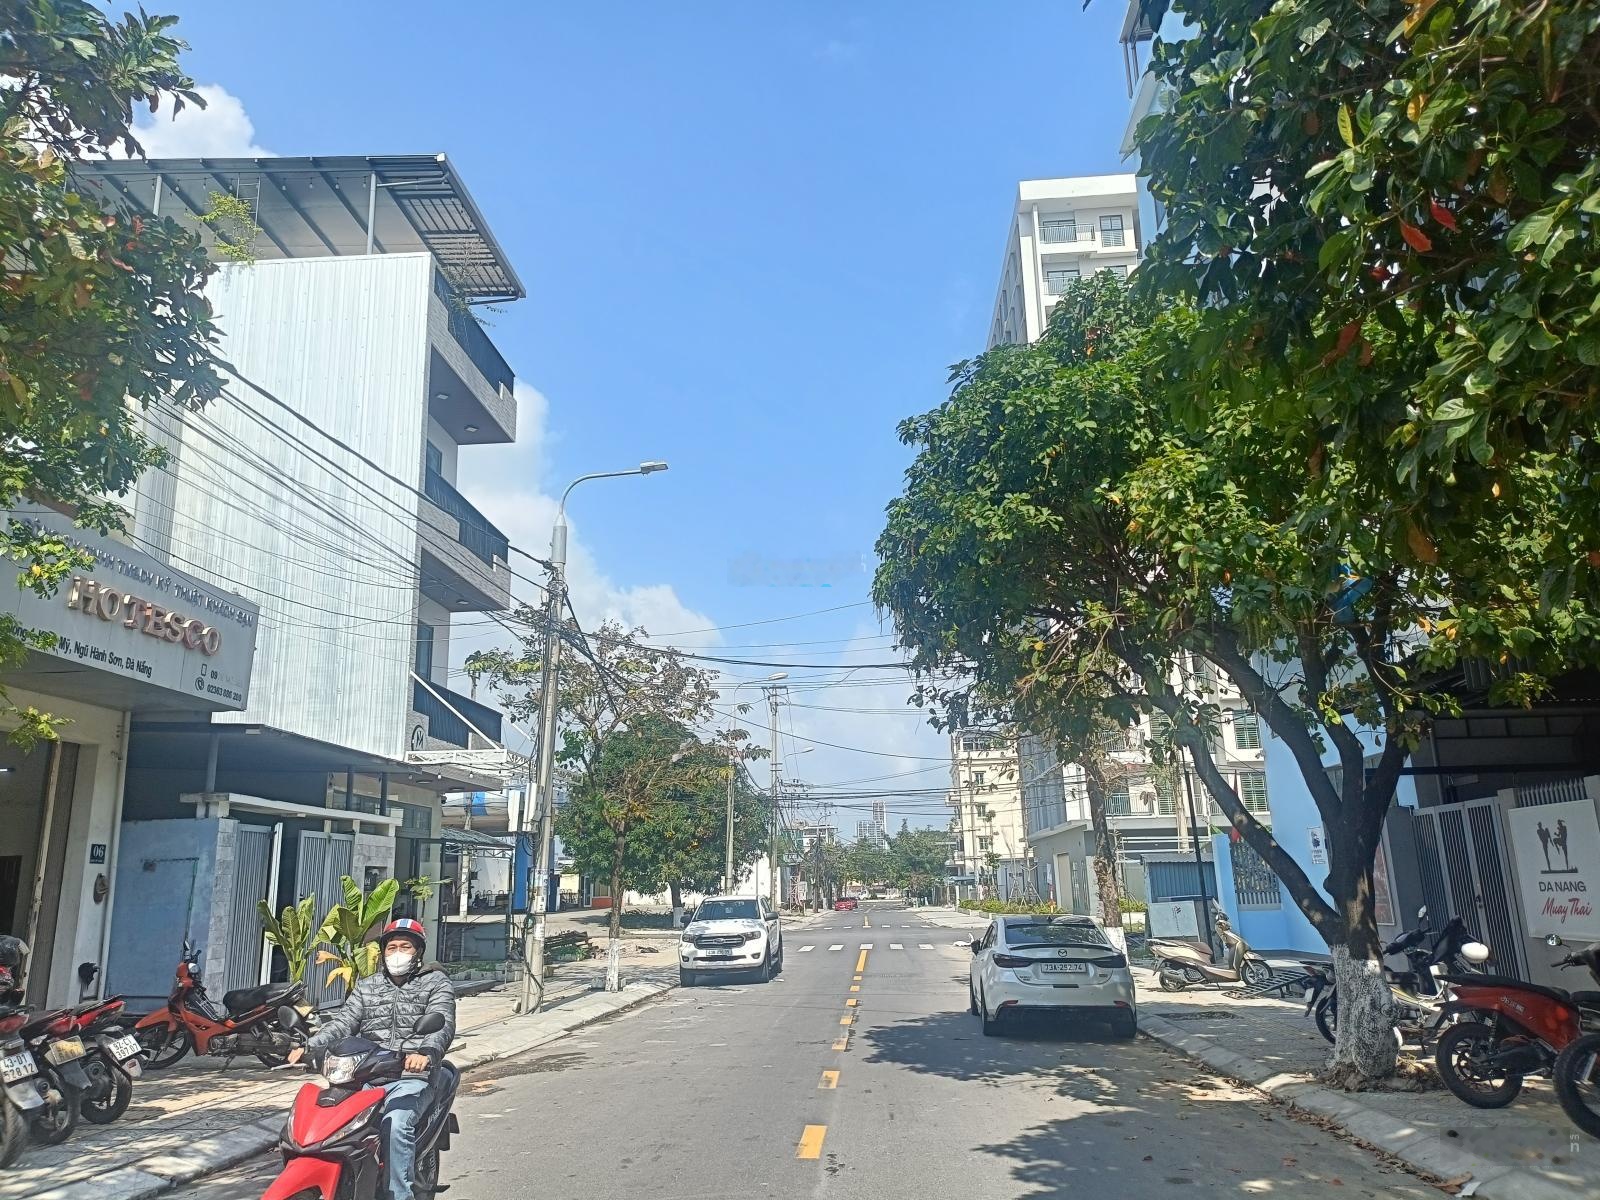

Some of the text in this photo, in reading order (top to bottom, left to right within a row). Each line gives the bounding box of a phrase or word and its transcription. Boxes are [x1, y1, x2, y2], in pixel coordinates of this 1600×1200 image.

[67, 575, 222, 656] HOTESCO
[74, 640, 89, 659] Ngũ
[89, 645, 107, 663] Hành
[93, 845, 105, 858] 06
[1538, 880, 1587, 893] DA NANG
[1541, 896, 1593, 924] Muay Thai
